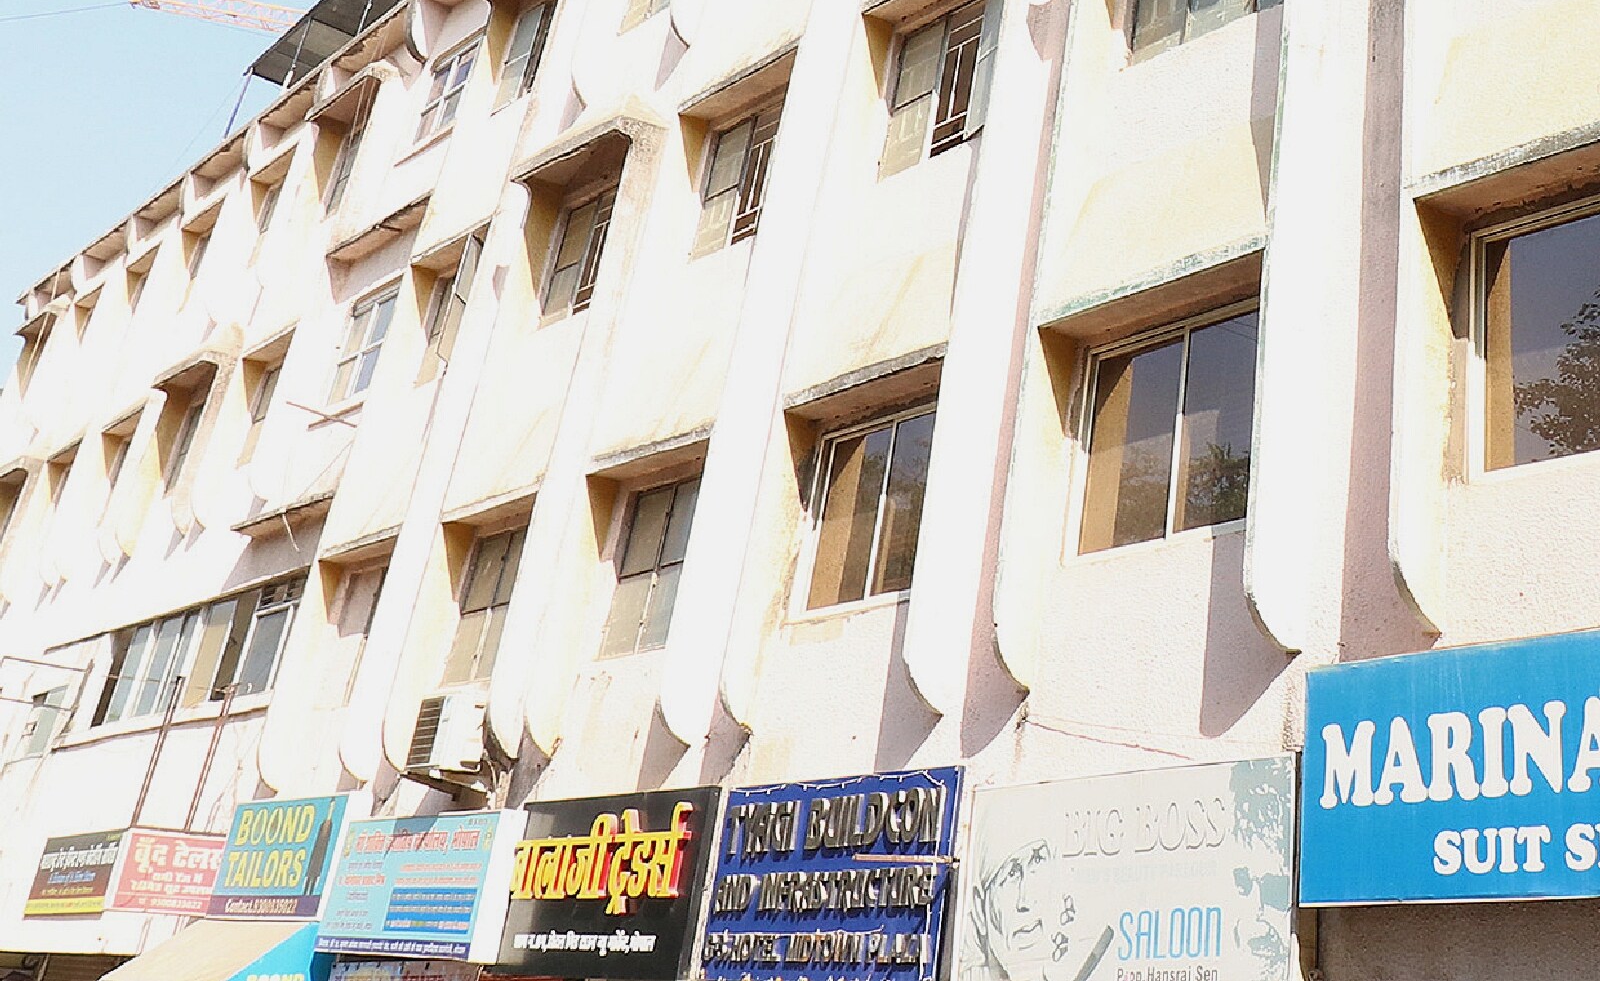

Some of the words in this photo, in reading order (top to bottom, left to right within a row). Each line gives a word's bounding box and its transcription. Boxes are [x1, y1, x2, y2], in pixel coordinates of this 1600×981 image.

[234, 804, 315, 846] BOOND
[1061, 809, 1125, 858] BIG
[1135, 797, 1231, 853] BOSS
[1432, 825, 1550, 876] SUIT
[225, 848, 306, 888] TAILORS
[510, 814, 614, 899] बालाजी
[1118, 906, 1222, 961] SALOON
